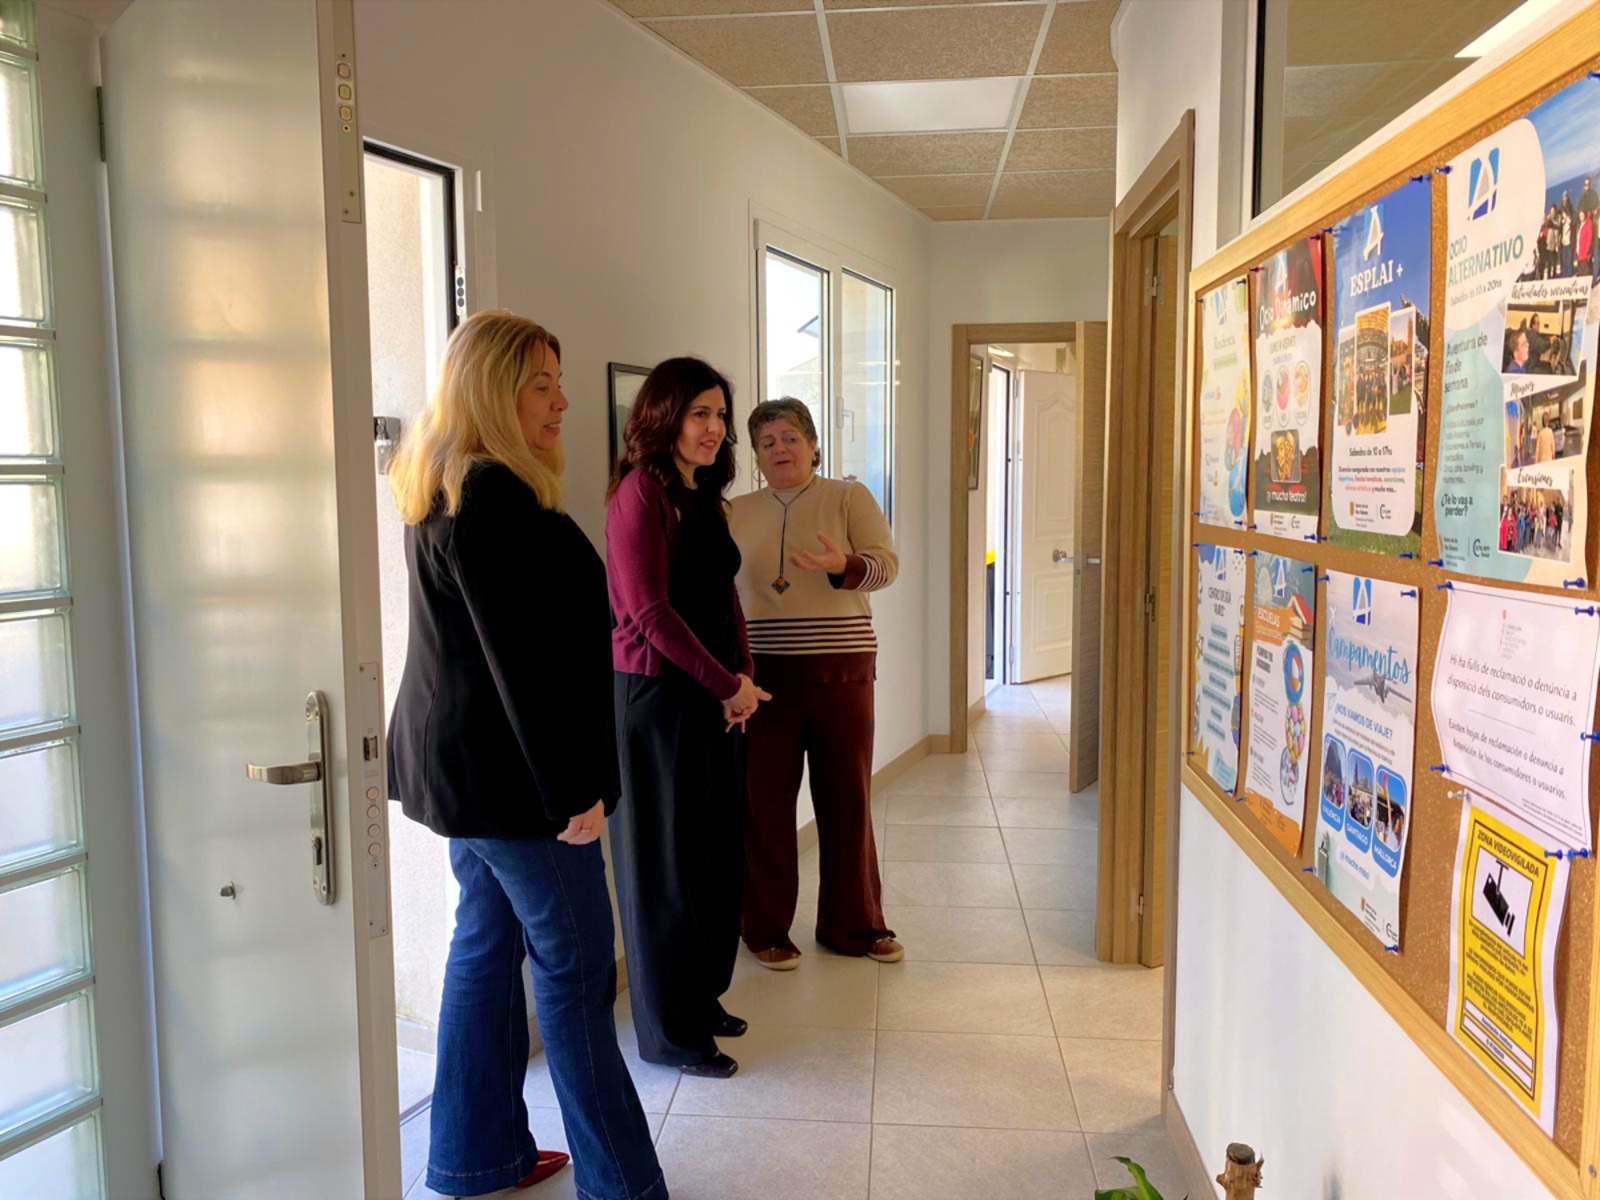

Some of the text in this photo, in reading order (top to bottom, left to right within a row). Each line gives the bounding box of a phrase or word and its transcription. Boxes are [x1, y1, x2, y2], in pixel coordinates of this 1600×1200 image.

[1449, 235, 1467, 260] OCIO
[1448, 234, 1524, 288] ALTERNATIVO
[1350, 260, 1394, 297] ESPLAI
[1511, 280, 1588, 299] Actividades recreativas
[1275, 290, 1316, 316] Dinámico
[1446, 331, 1488, 357] Aventura de
[1517, 467, 1552, 487] Excursiones
[1445, 505, 1468, 518] perder?
[1457, 496, 1469, 505] vas
[1328, 626, 1411, 685] Campamentos
[1450, 654, 1577, 701] Hi ha fulls de reclamació o denúncia a
[1447, 676, 1576, 726] disposició dels consumidors o usuaris.
[1449, 718, 1564, 776] Existen hojas de reclamación o denuncia a
[1478, 752, 1484, 762] de
[1485, 754, 1493, 767] los
[1493, 759, 1532, 785] consumidores
[1538, 780, 1566, 800] usuarios.
[1346, 823, 1368, 846] SANTIAGO
[1374, 845, 1397, 870] MALLORCA
[1477, 829, 1540, 878] ZONA VIDEOVIGILADA
